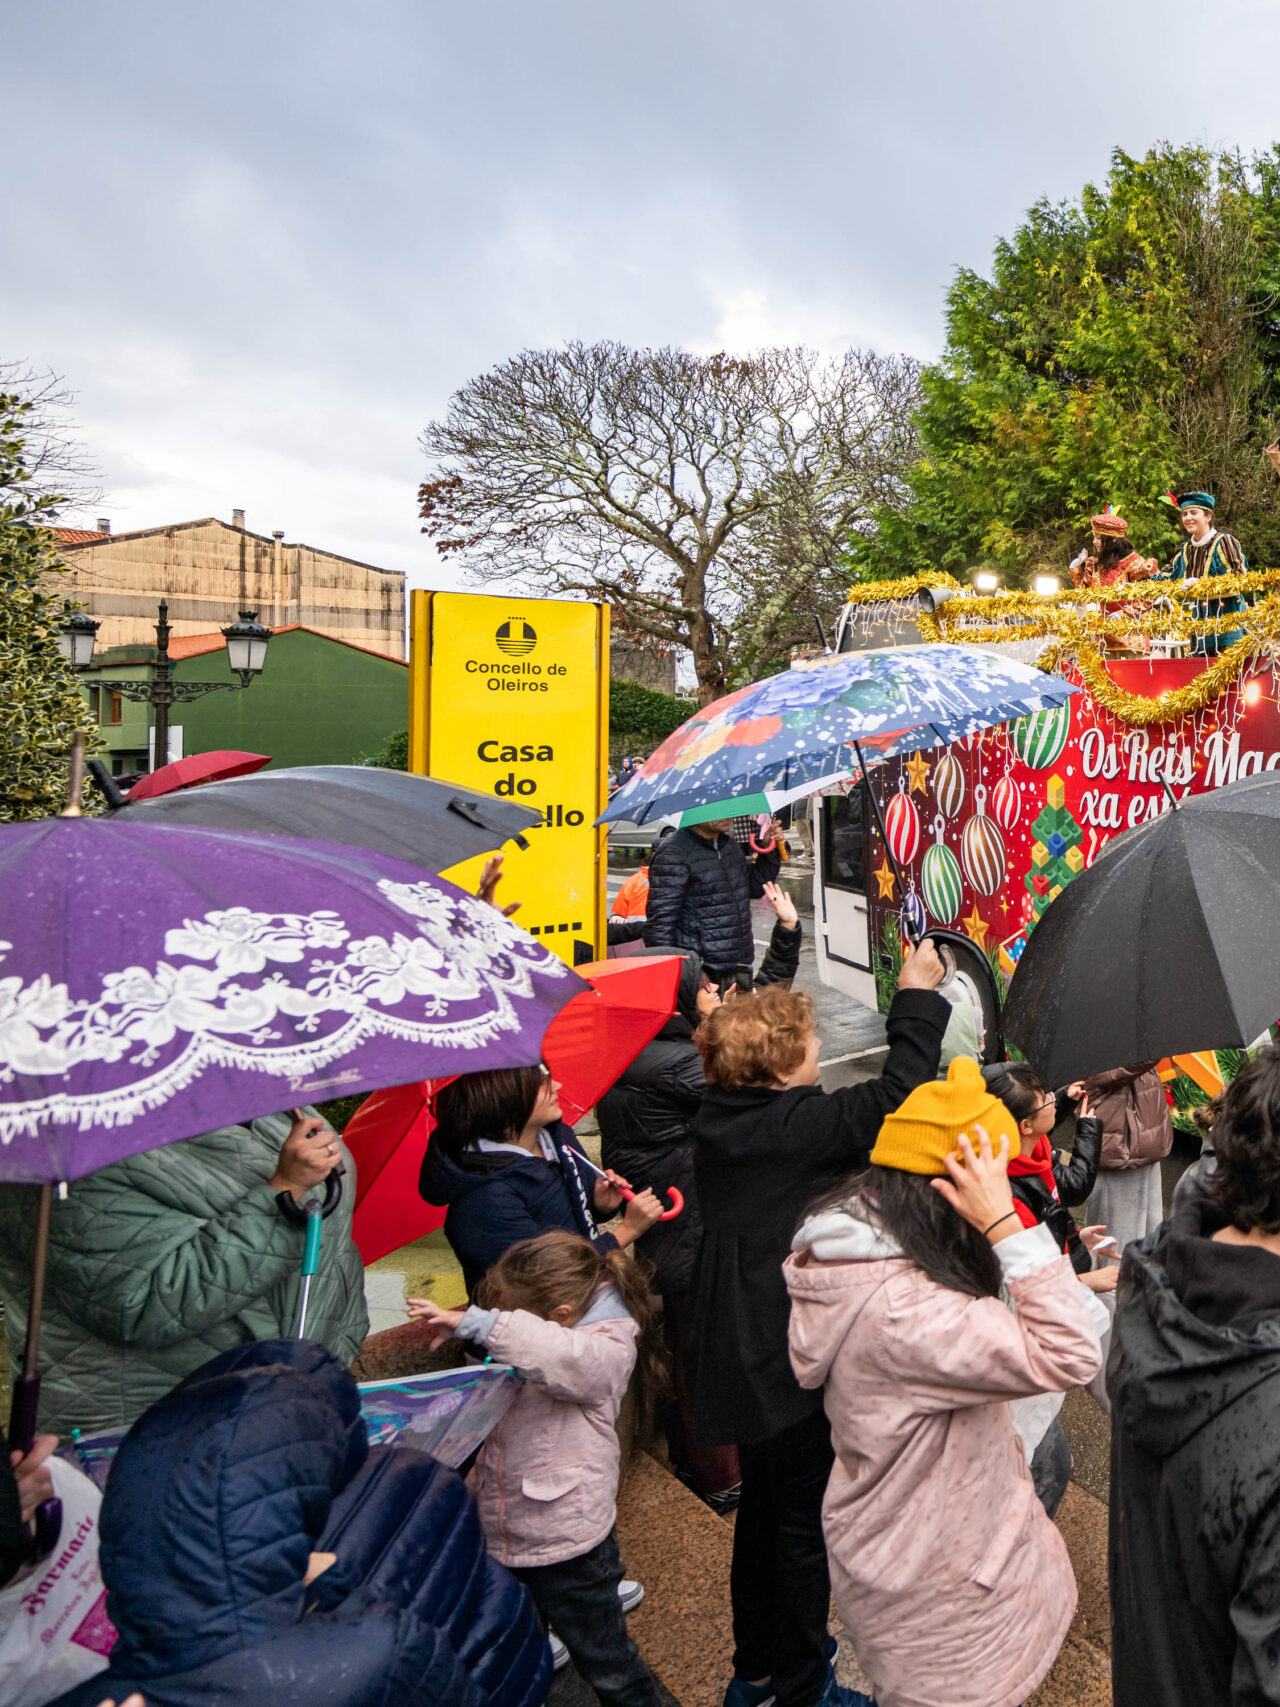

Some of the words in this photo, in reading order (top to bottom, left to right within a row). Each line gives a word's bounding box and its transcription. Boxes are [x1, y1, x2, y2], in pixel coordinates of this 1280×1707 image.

[465, 660, 542, 675] Concello
[547, 663, 567, 676] de
[487, 678, 548, 692] Oleiros
[477, 740, 554, 763] Casa
[1079, 727, 1121, 780] Os
[1124, 729, 1196, 785] Reis
[494, 772, 537, 797] do
[1079, 788, 1122, 828] xa
